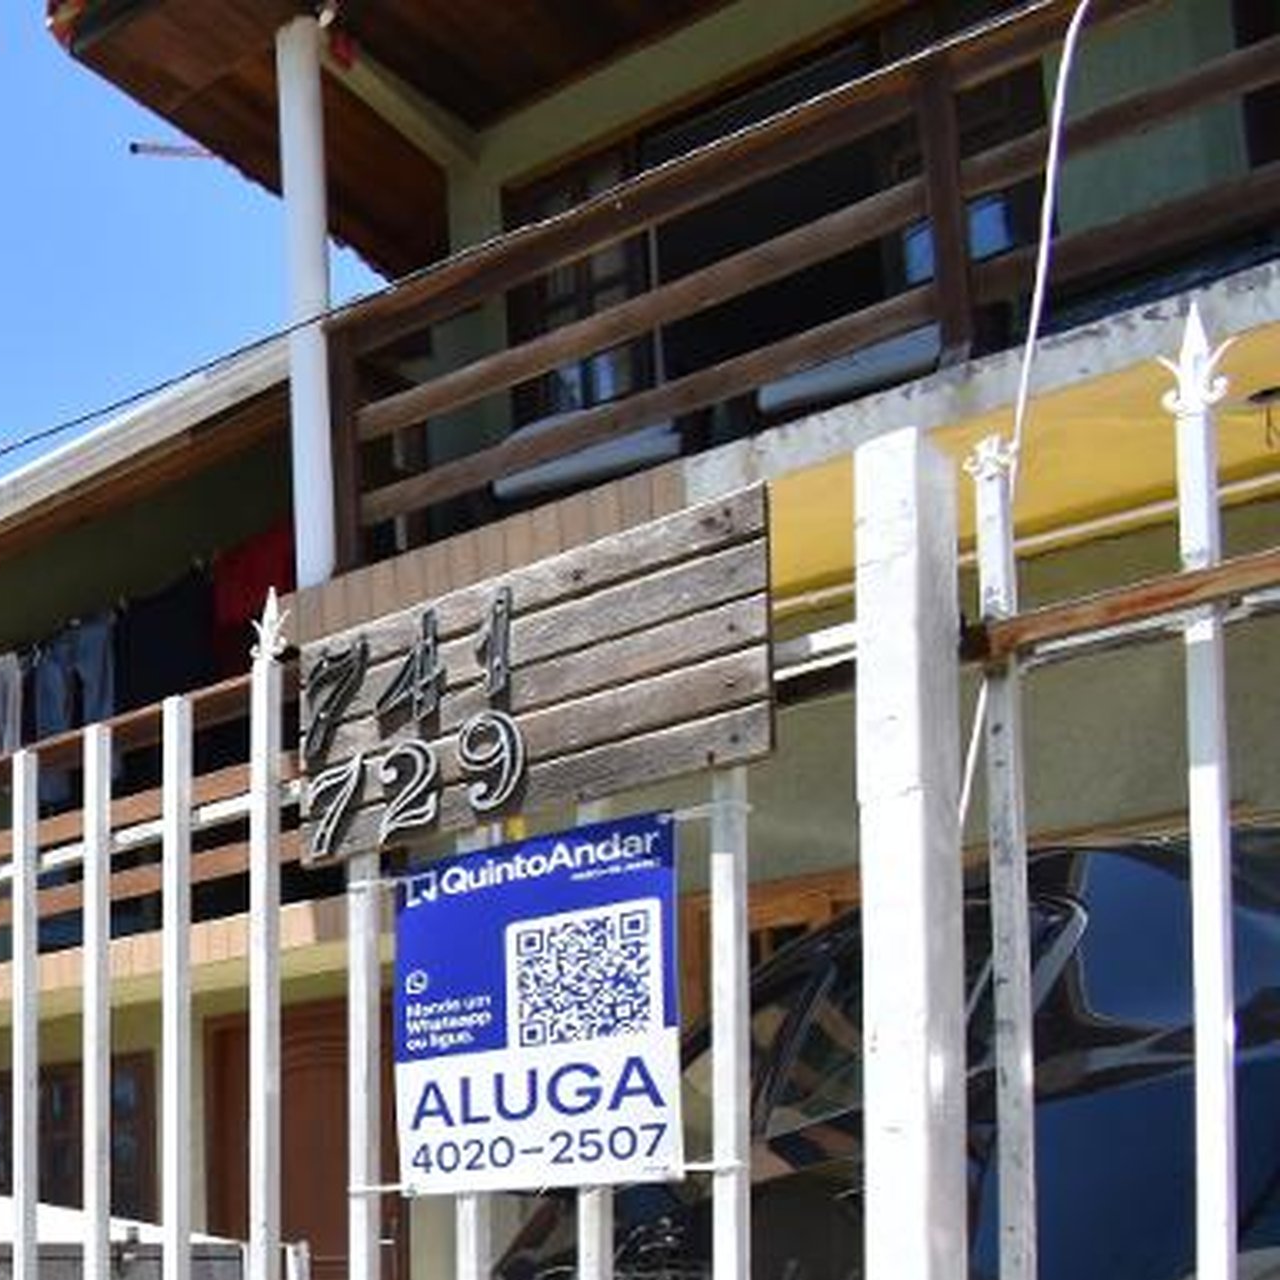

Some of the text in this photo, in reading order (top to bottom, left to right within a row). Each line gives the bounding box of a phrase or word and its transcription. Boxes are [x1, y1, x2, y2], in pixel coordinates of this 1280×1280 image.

[304, 585, 513, 768] 741
[309, 709, 527, 858] 729
[441, 831, 660, 895] QuintoAndar
[406, 1038, 428, 1052] ou
[410, 1055, 667, 1131] ALUGA
[411, 1122, 668, 1175] 4020-2507
